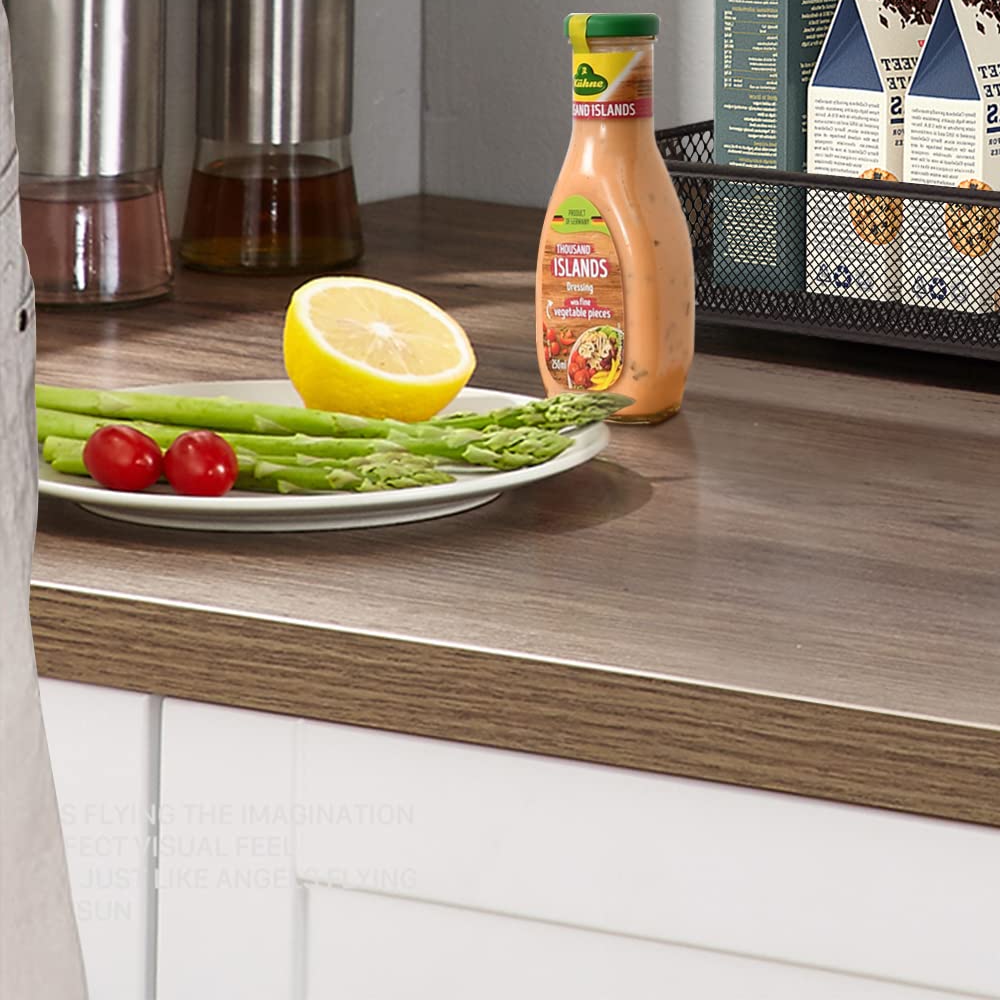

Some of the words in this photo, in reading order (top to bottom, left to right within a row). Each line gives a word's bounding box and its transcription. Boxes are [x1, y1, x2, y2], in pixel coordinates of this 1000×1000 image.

[591, 103, 636, 117] ISLANDS
[556, 244, 591, 255] THOUSAND
[553, 257, 609, 278] ISLANDS
[566, 281, 594, 295] Dressing
[554, 306, 587, 321] vegetable
[587, 307, 612, 321] pieces
